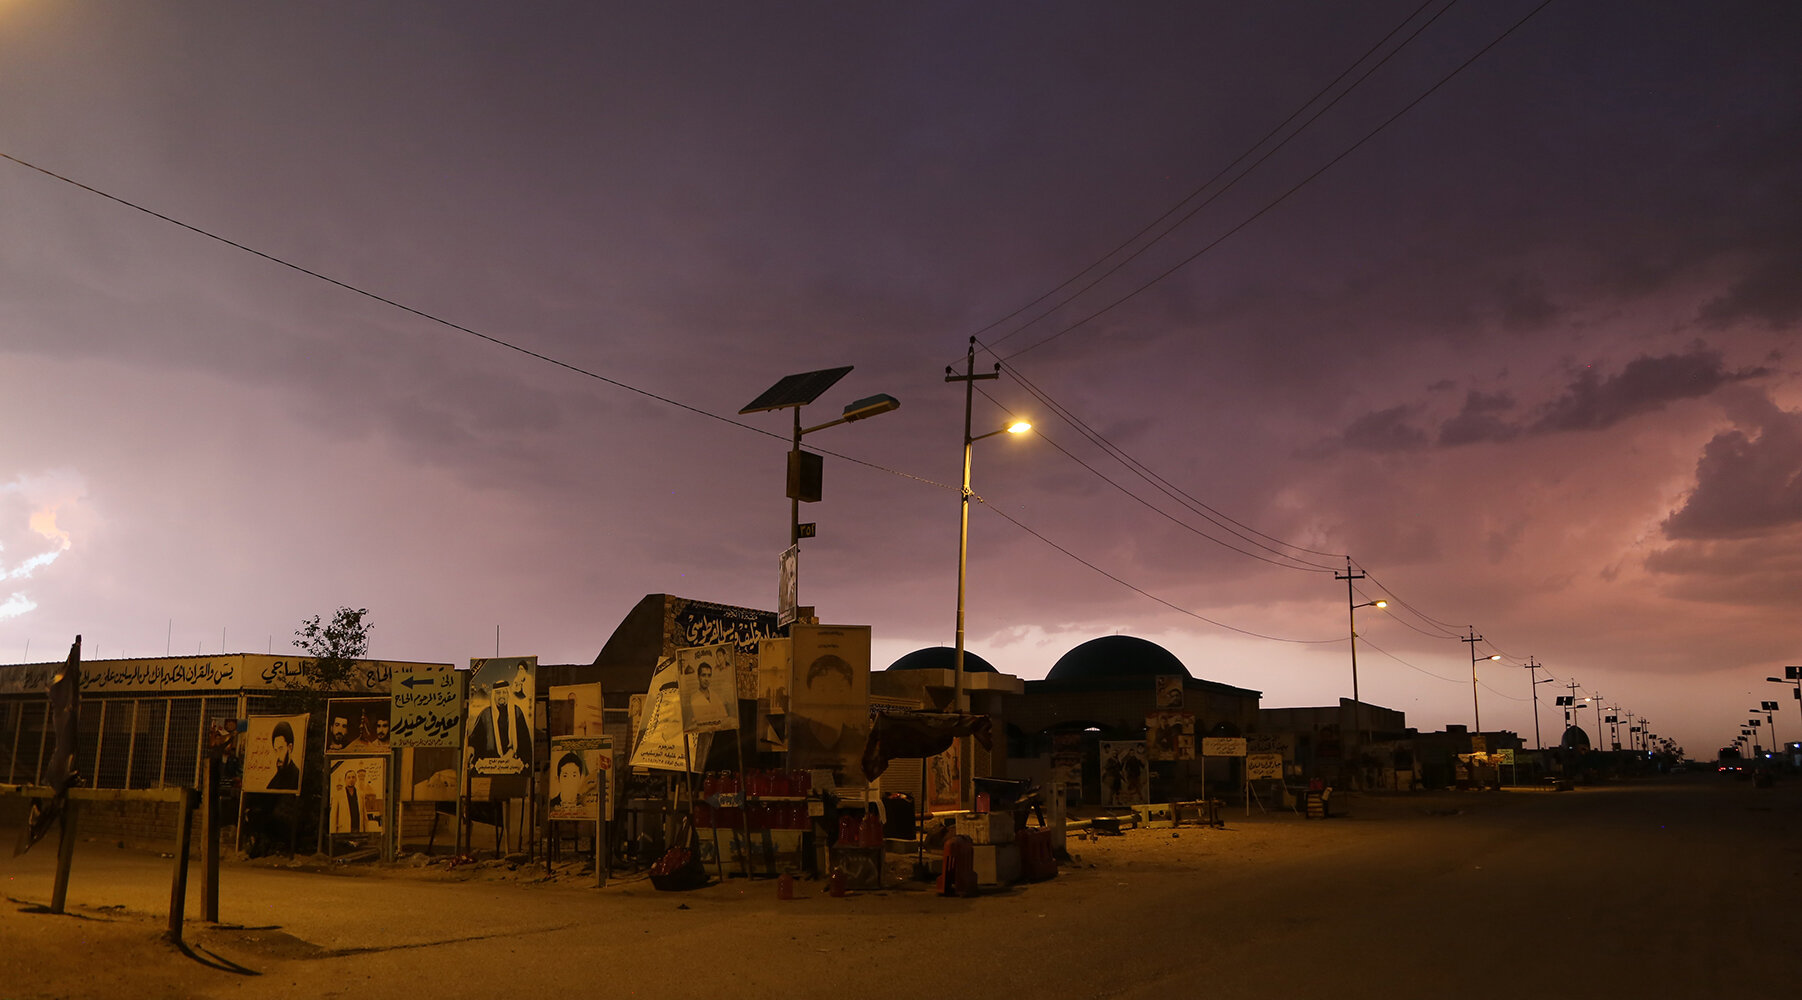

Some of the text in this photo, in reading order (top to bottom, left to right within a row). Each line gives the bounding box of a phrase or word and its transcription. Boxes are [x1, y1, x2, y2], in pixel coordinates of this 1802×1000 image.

[100, 667, 115, 687] على
[160, 664, 185, 689] الحكيم
[395, 692, 456, 708] مقبرة المرحوم الحاج
[390, 710, 459, 739] معيوف حيدر
